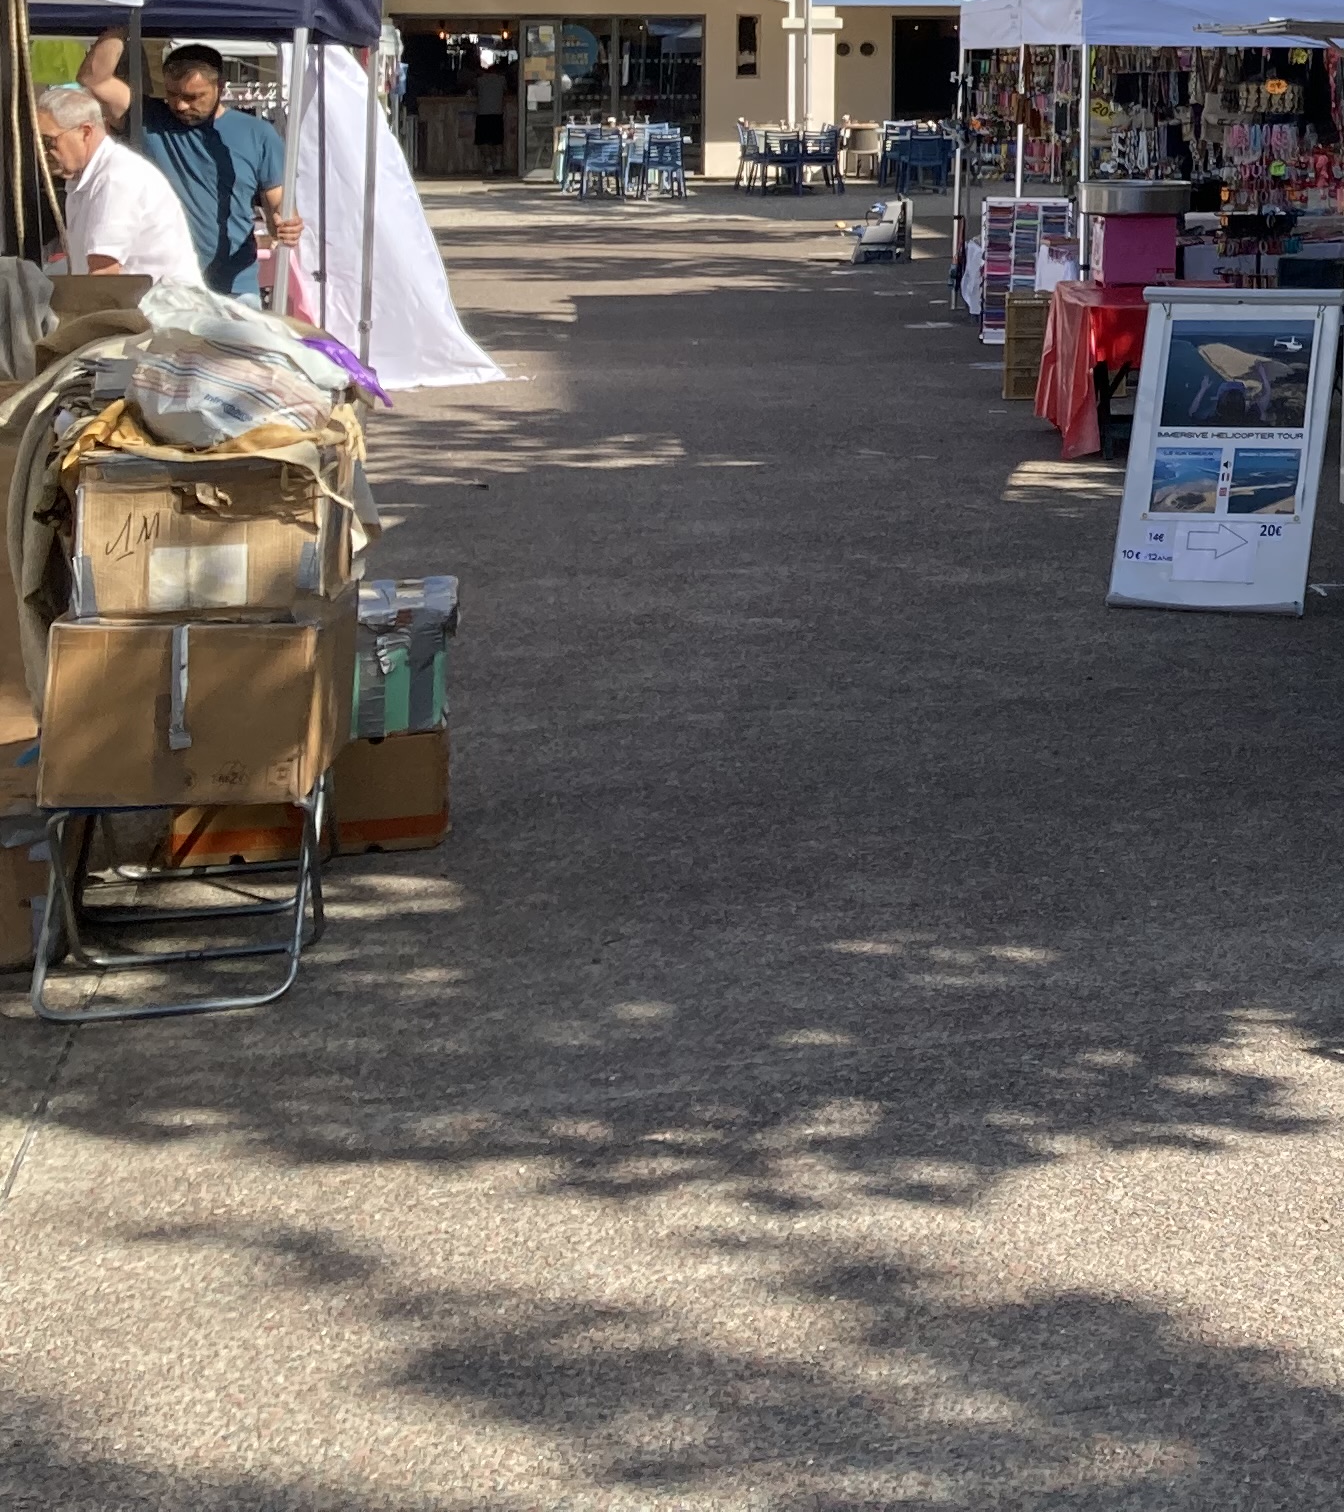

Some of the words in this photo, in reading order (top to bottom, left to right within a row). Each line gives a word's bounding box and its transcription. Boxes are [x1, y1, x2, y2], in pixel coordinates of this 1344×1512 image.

[1211, 432, 1274, 440] HELICOPTER
[1277, 432, 1304, 440] TOUR
[1259, 524, 1282, 537] 20€
